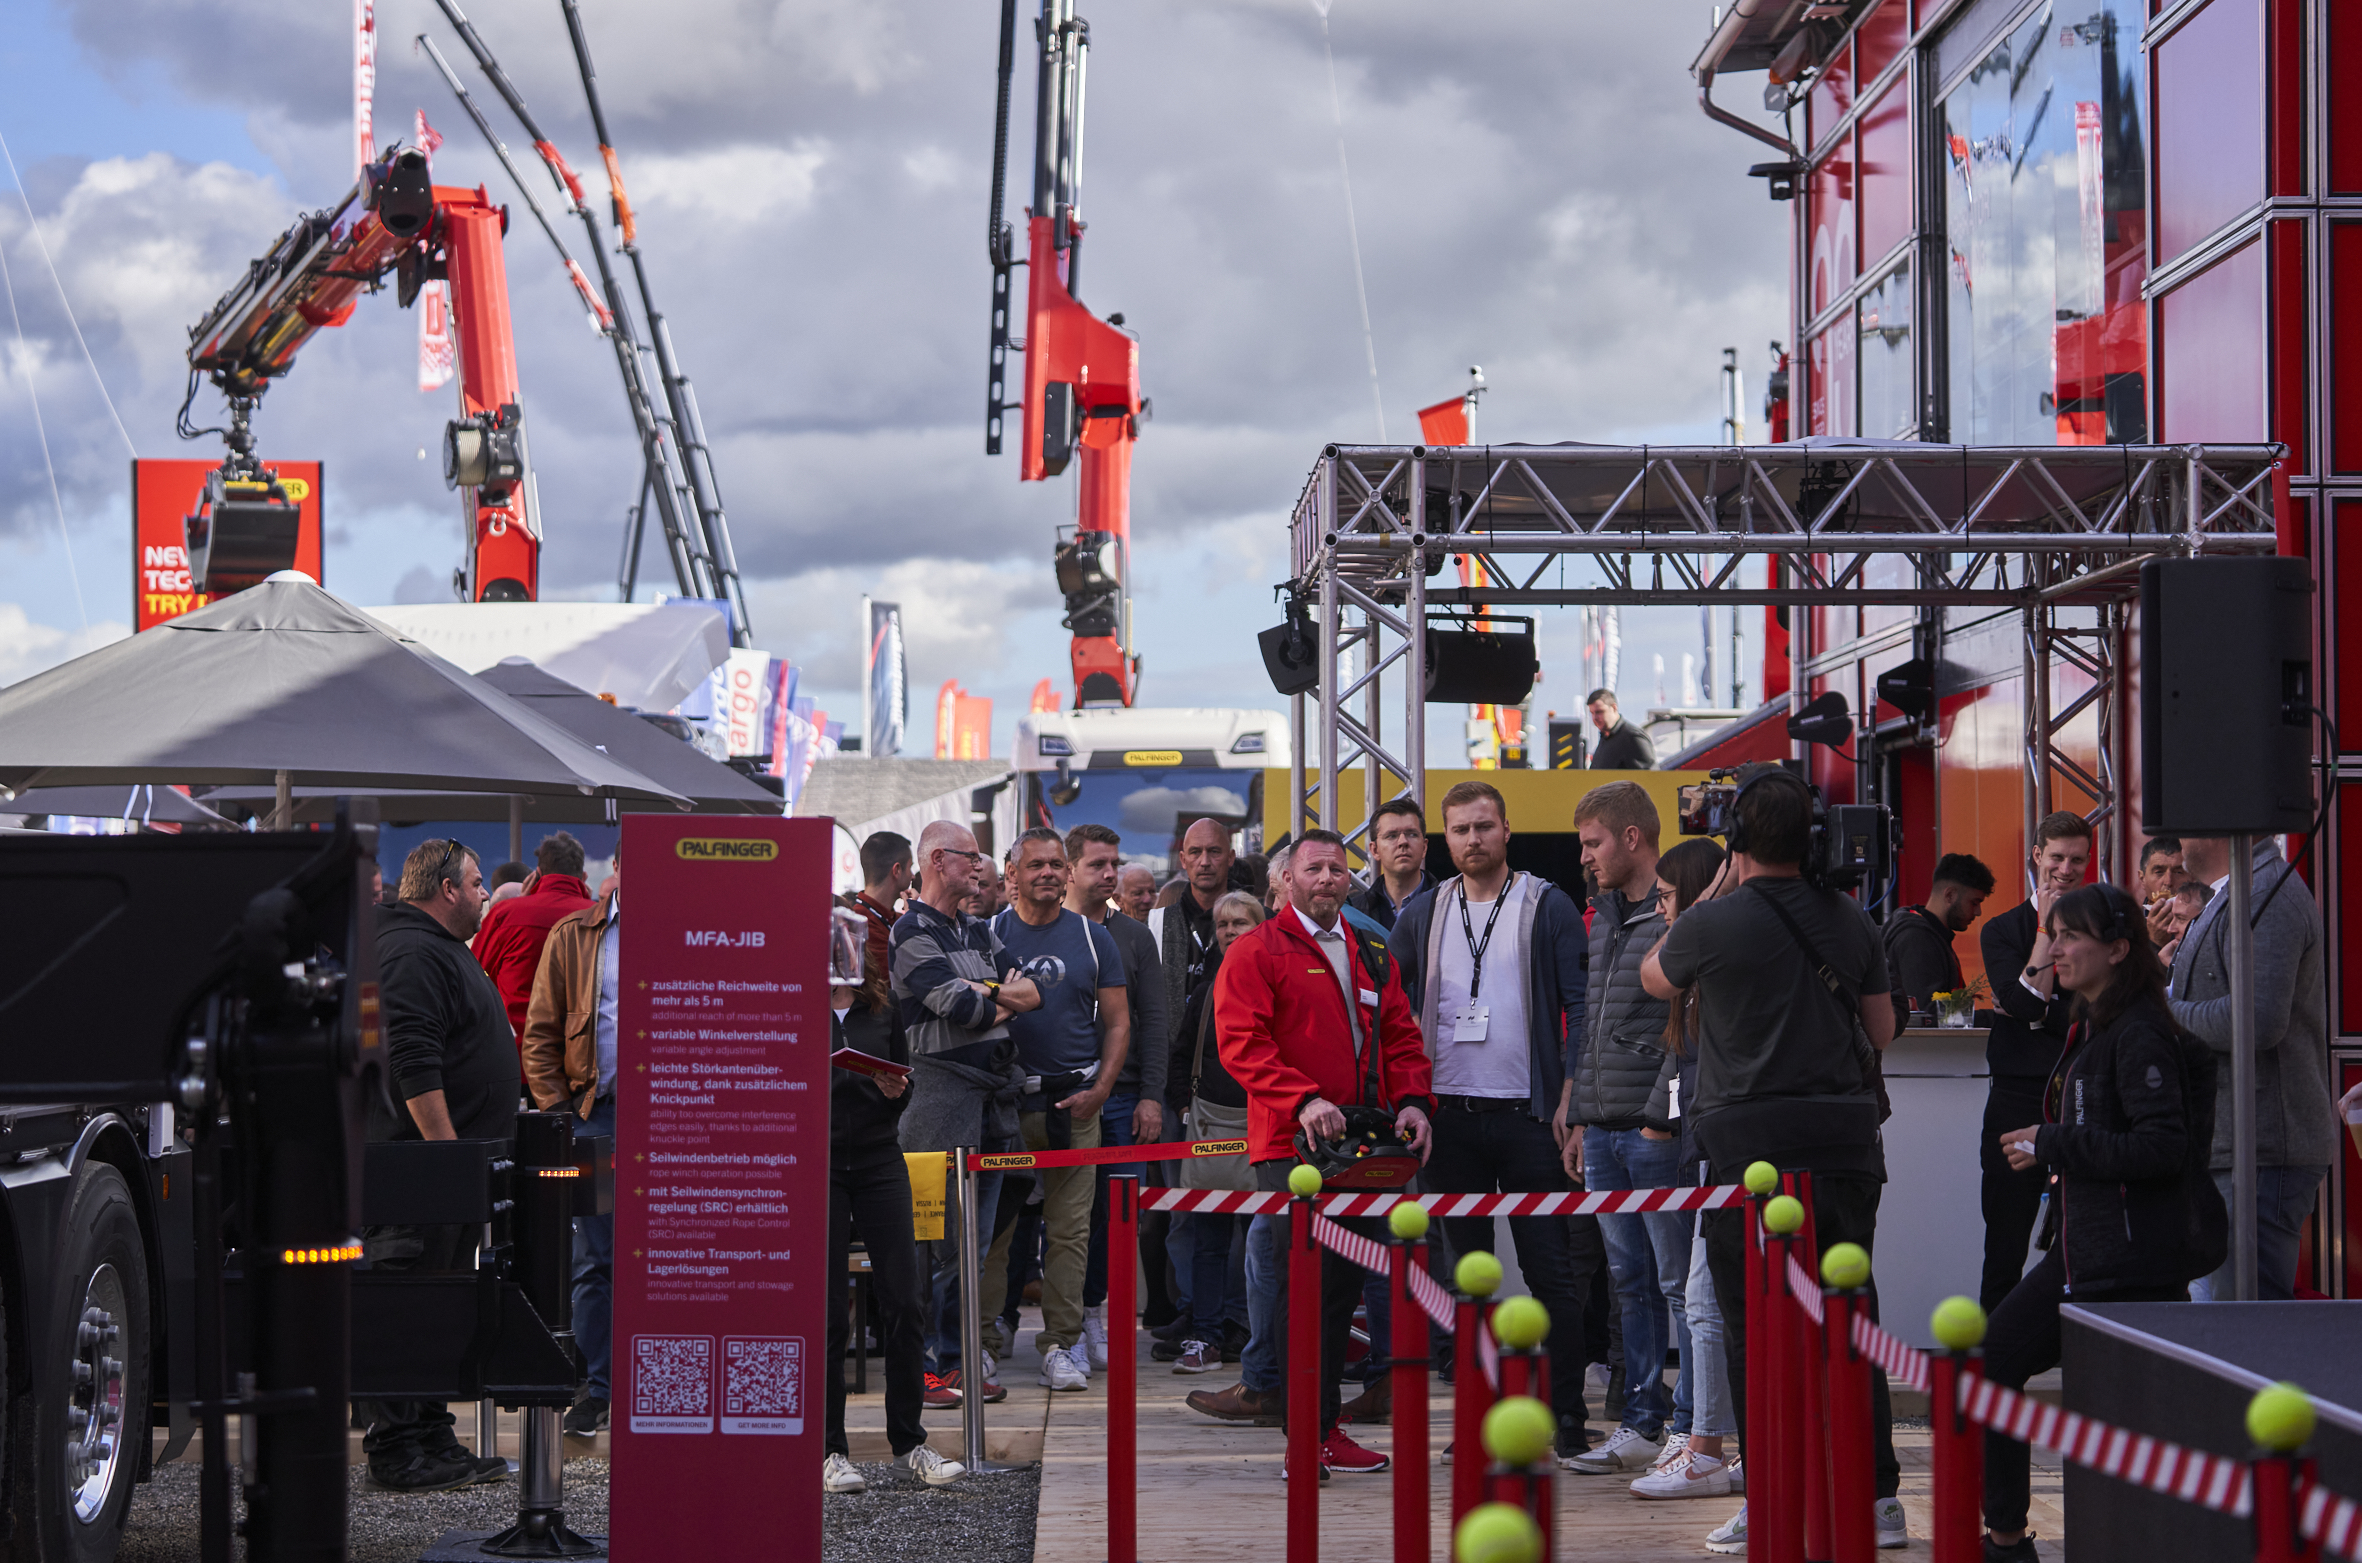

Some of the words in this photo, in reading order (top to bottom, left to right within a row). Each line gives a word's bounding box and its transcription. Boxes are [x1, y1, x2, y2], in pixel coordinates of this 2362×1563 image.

[144, 594, 193, 616] TRY
[730, 669, 758, 756] argo
[683, 842, 772, 856] PALFINGER
[686, 931, 765, 946] MFA-JIB
[653, 980, 715, 990] zusätzliche
[718, 980, 779, 991] Reichweite
[782, 983, 802, 992] von
[653, 996, 680, 1005] mehr
[684, 996, 700, 1006] als
[703, 996, 710, 1006] 5
[653, 1012, 696, 1020] additional
[700, 1012, 724, 1020] reach
[727, 1012, 735, 1020] of
[763, 1013, 782, 1021] than
[785, 1013, 791, 1021] 5
[652, 1030, 696, 1039] variable
[700, 1030, 798, 1043] Winkelverstellung
[690, 1046, 713, 1056] angle
[716, 1046, 766, 1056] adjustment
[651, 1063, 689, 1073] leichte
[692, 1063, 783, 1075] Störkantenüber-
[651, 1079, 701, 1090] windung,
[704, 1079, 732, 1089] dank
[735, 1080, 807, 1090] zusätzlichem
[651, 1094, 714, 1106] Knickpunkt
[2076, 1079, 2084, 1125] PALFINGER
[650, 1110, 677, 1120] ability
[742, 1111, 796, 1120] interference
[650, 1123, 677, 1132] edges
[680, 1123, 706, 1132] easily,
[710, 1123, 740, 1131] thanks
[753, 1123, 797, 1132] additional
[650, 1135, 685, 1143] knuckle
[687, 1135, 710, 1144] point
[1195, 1142, 1244, 1153] PALFINGER
[650, 1152, 750, 1163] Seilwindenbetrieb
[753, 1154, 796, 1167] möglich
[983, 1156, 1033, 1166] PALFINGER
[672, 1169, 698, 1178] winch
[701, 1169, 743, 1179] operation
[746, 1170, 782, 1179] possible
[649, 1186, 668, 1196] mit
[672, 1186, 787, 1200] Seilwindensynchron-
[649, 1203, 697, 1214] regelung
[700, 1202, 733, 1214] (SRC)
[736, 1203, 788, 1213] erhältlich
[649, 1218, 668, 1226] with
[670, 1218, 730, 1228] Synchronized
[733, 1219, 755, 1228] Rope
[758, 1219, 790, 1228] Control
[649, 1230, 674, 1239] (SRC)
[677, 1230, 716, 1239] available
[648, 1248, 705, 1258] innovative
[708, 1248, 766, 1261] Transport-
[769, 1250, 790, 1259] und
[648, 1264, 729, 1276] Lagerlösungen
[648, 1280, 692, 1289] innovative
[695, 1281, 736, 1290] transport
[758, 1282, 794, 1291] stowage
[648, 1292, 687, 1301] solutions
[690, 1293, 729, 1301] available
